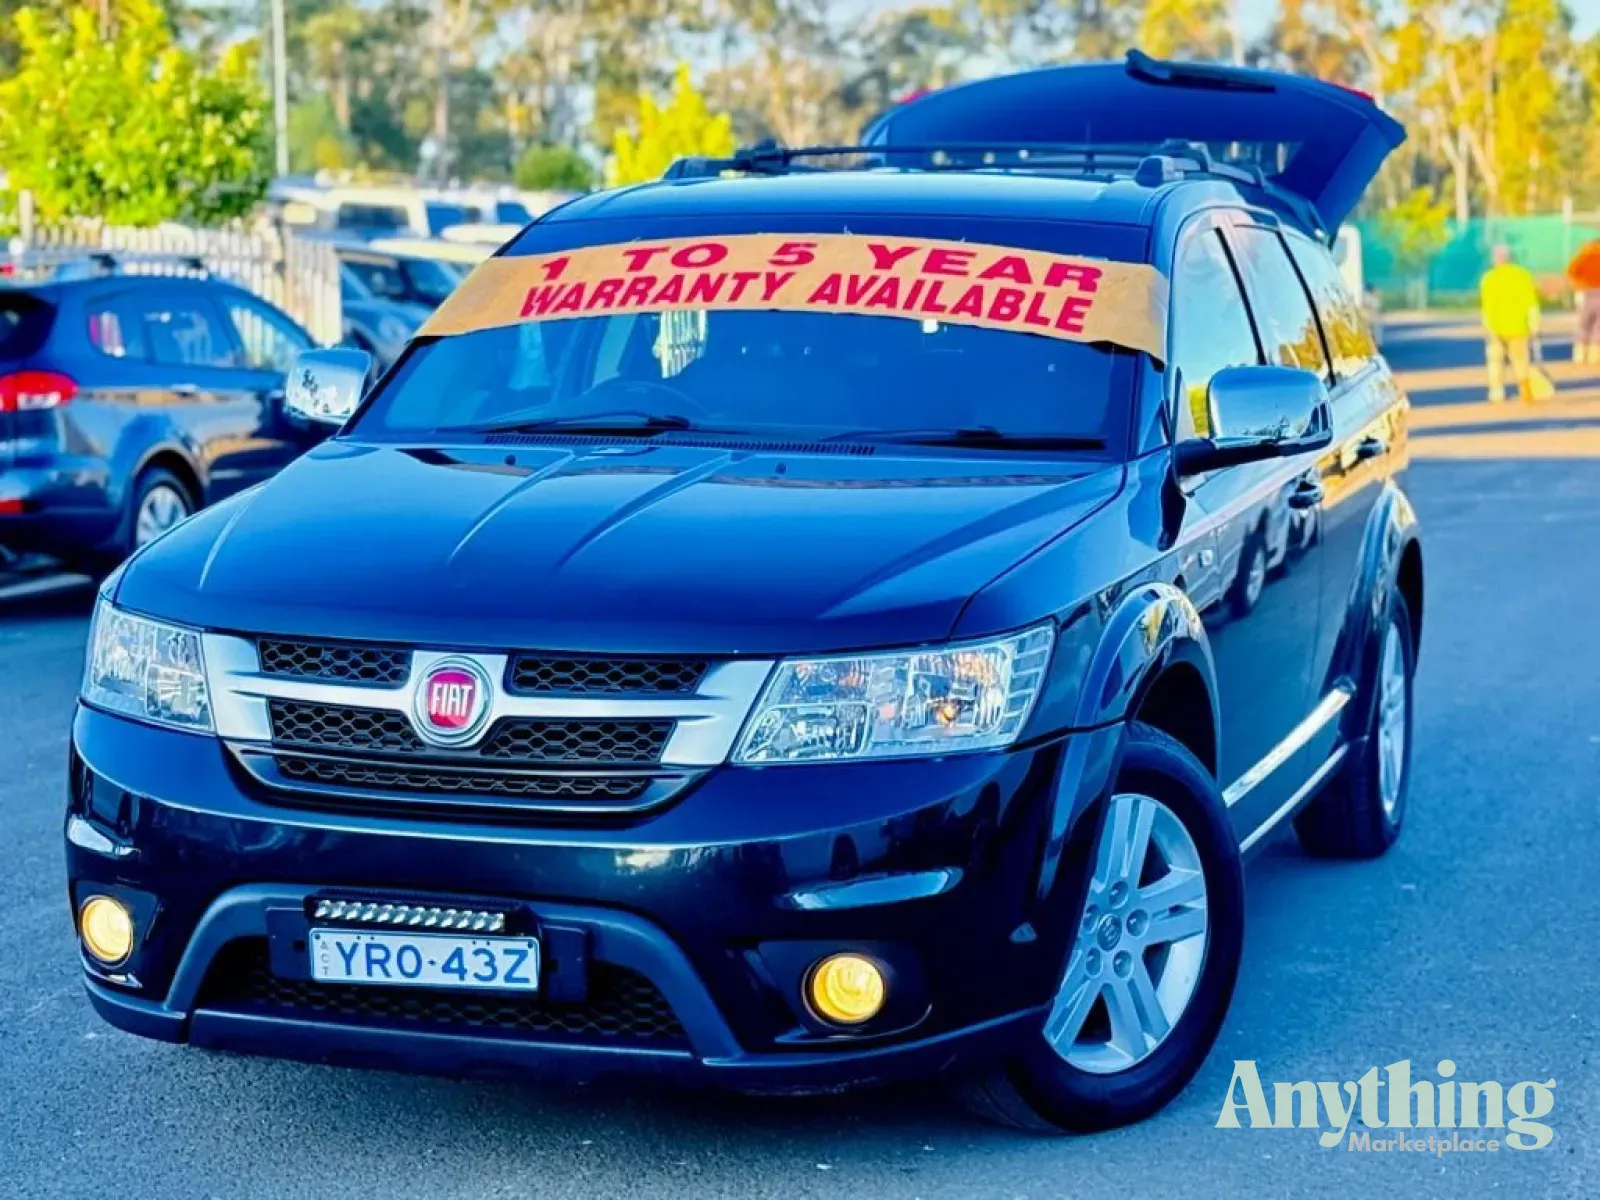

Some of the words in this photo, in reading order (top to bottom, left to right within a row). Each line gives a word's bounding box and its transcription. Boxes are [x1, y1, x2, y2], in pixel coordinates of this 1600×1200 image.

[541, 256, 571, 281] 1
[622, 243, 728, 272] TO
[768, 242, 818, 267] 5
[867, 244, 1103, 292] YEAR
[519, 271, 797, 317] WARRANTY
[806, 273, 1094, 333] AVAILABLE
[430, 682, 473, 717] FIAT
